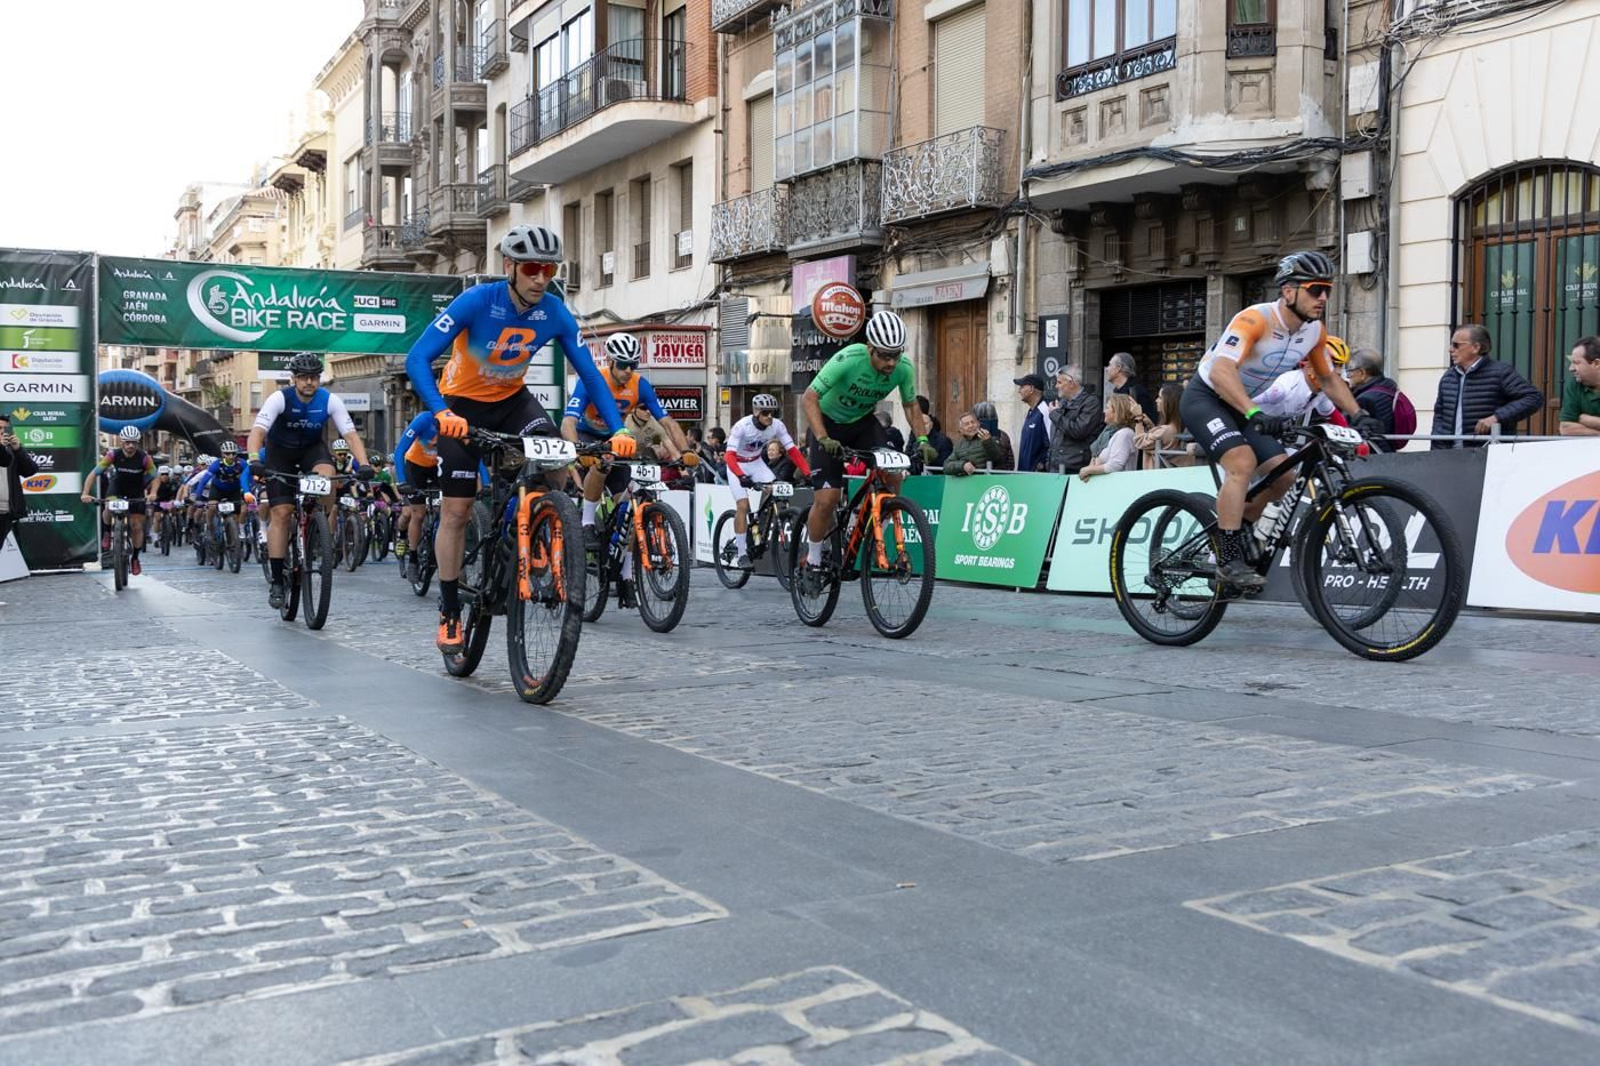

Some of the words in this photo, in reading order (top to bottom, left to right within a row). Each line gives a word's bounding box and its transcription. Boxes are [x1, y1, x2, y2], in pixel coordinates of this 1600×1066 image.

[114, 268, 153, 280] Andalucía
[0, 277, 48, 290] ndalucía
[123, 290, 167, 301] GRANADA
[230, 281, 346, 312] Andalucía
[361, 297, 378, 306] UCI
[123, 301, 148, 310] JAÉN
[821, 301, 860, 315] Mahou
[123, 312, 167, 323] CÓRDOBA
[231, 308, 281, 328] BIKE
[287, 311, 347, 331] RACE
[359, 319, 401, 328] GARMIN
[434, 313, 455, 333] B
[652, 334, 704, 344] OPORTUNIDADES
[653, 344, 704, 357] JAVIER
[3, 383, 74, 393] GARMIN
[100, 396, 156, 407] ARMIN
[568, 397, 580, 407] B
[660, 399, 698, 409] JAVIER
[532, 439, 569, 455] 51-2
[882, 452, 904, 464] 71-1
[636, 465, 657, 478] 46-1
[305, 480, 327, 492] 71-2
[776, 483, 791, 494] 42-2
[1265, 476, 1306, 557] S-WORKS
[954, 554, 978, 566] SPORT
[979, 556, 1016, 569] BEARINGS
[1324, 575, 1355, 588] PRO
